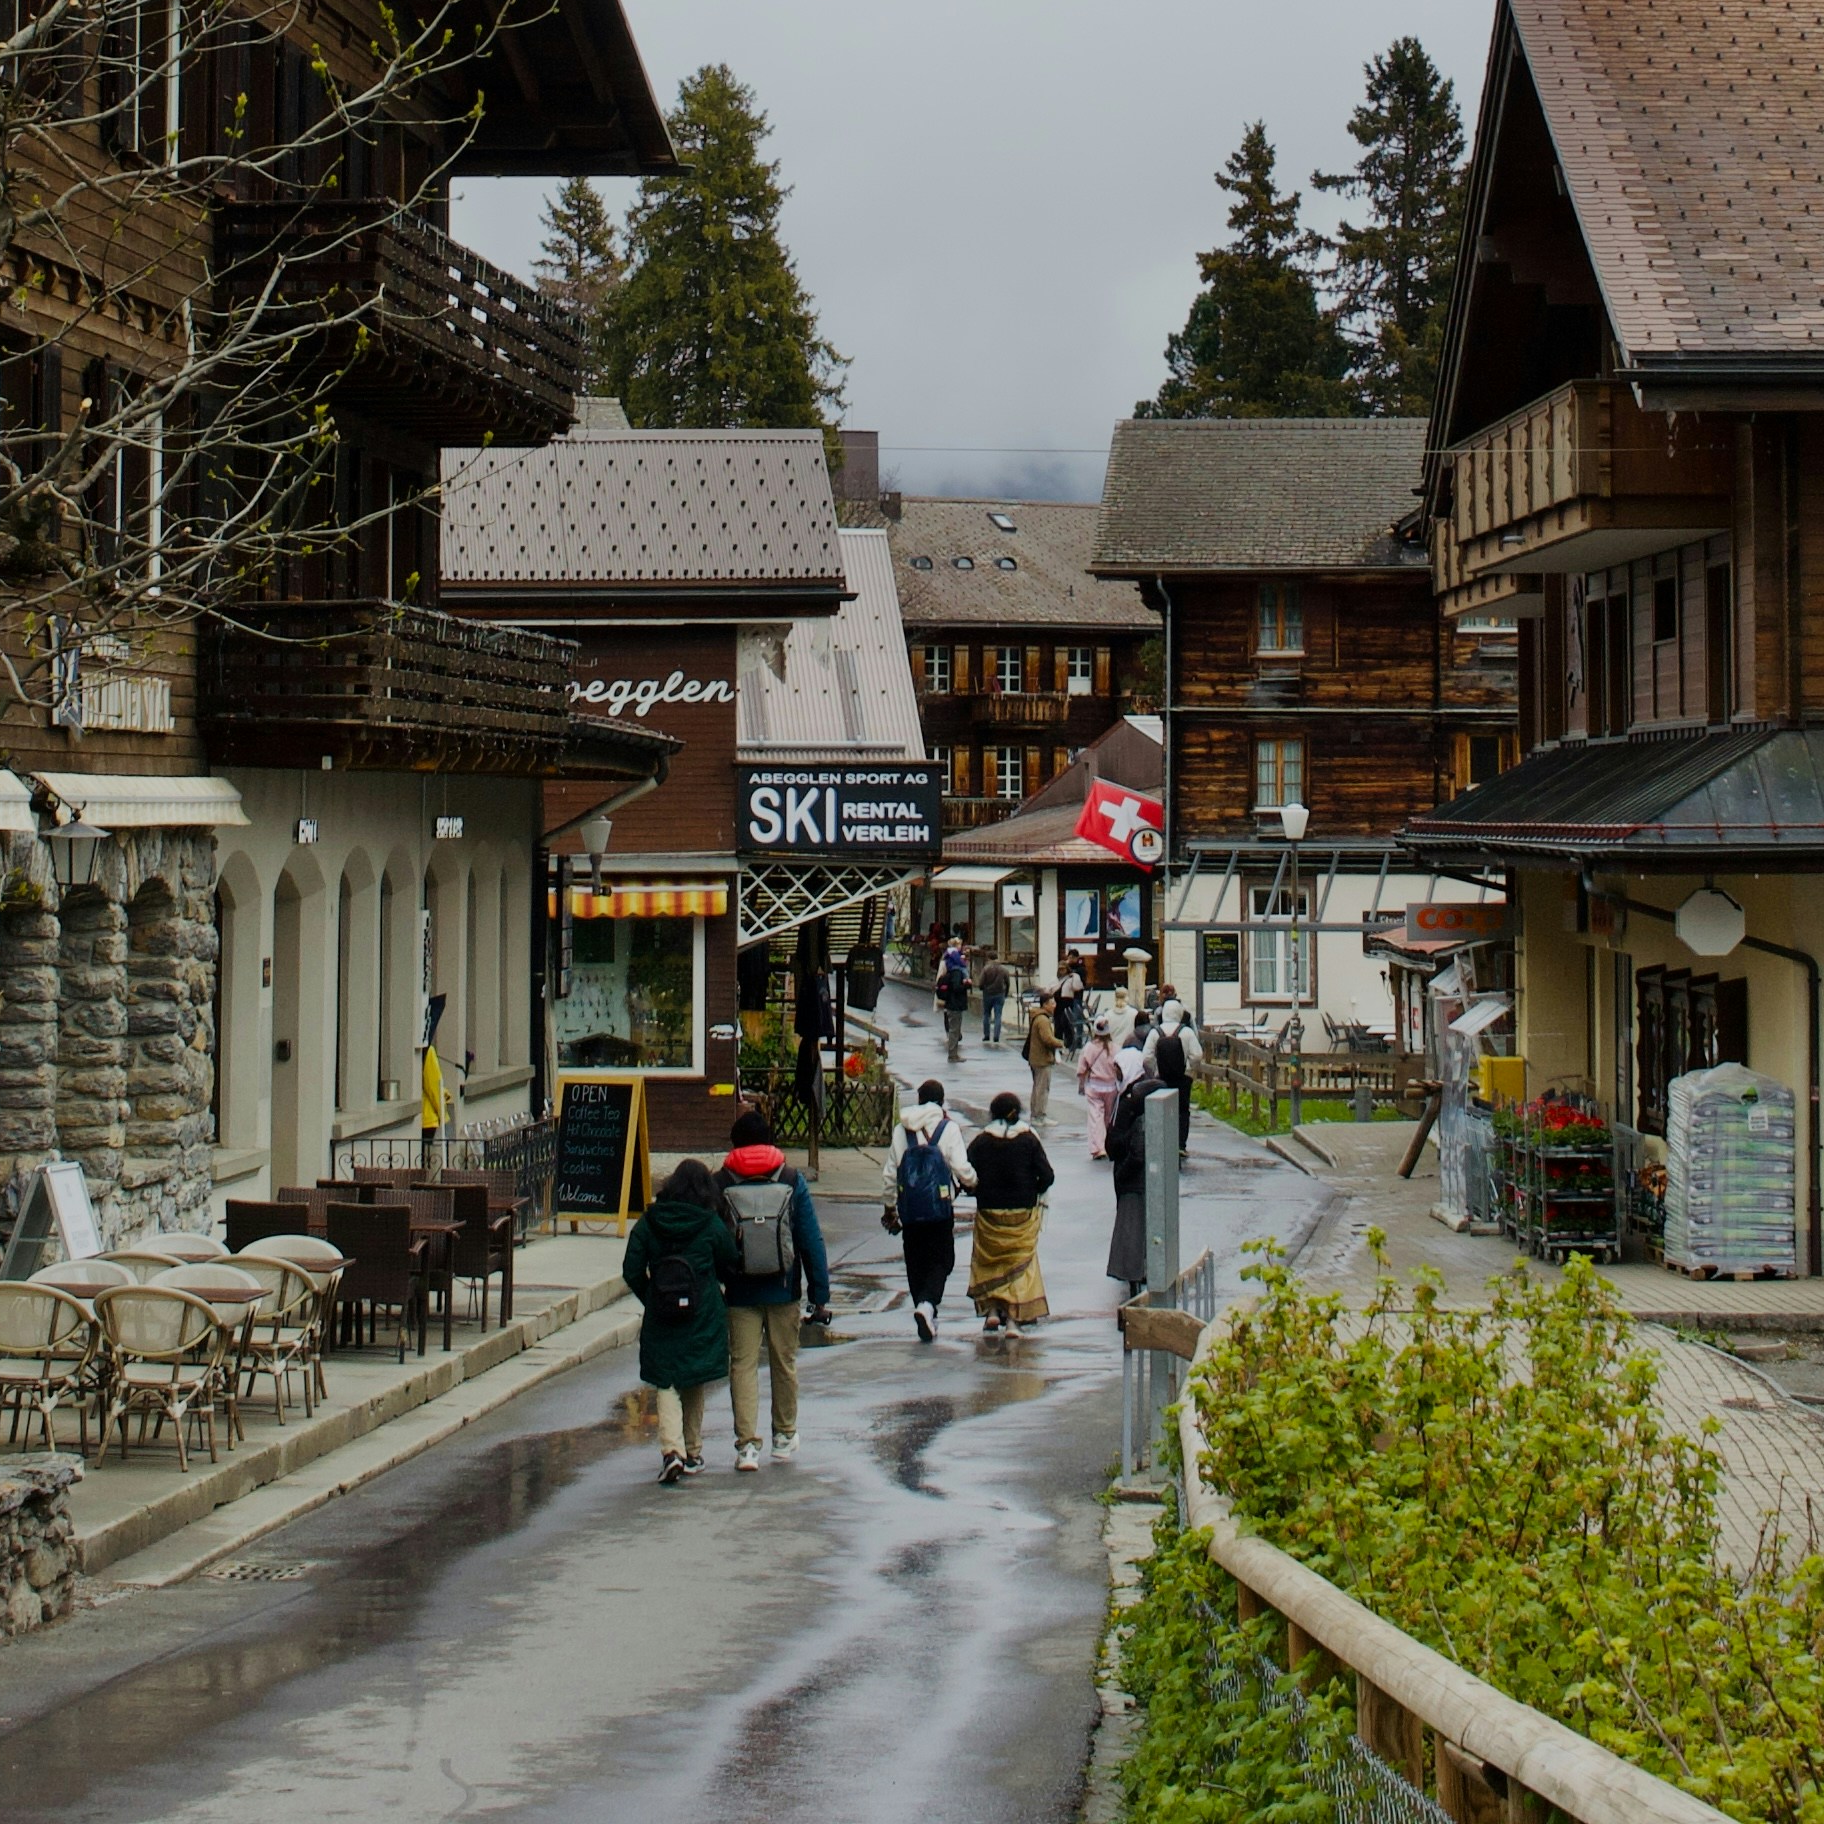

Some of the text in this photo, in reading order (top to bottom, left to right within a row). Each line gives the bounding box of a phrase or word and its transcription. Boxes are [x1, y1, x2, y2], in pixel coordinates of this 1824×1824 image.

[749, 773, 928, 784] ABEGGLEN SPORT AG
[750, 787, 838, 844] SKI
[842, 802, 923, 819] RENTAL
[842, 825, 929, 842] VERLEIH
[571, 1085, 608, 1102] OPEN
[568, 1106, 621, 1120] Coffee Tea
